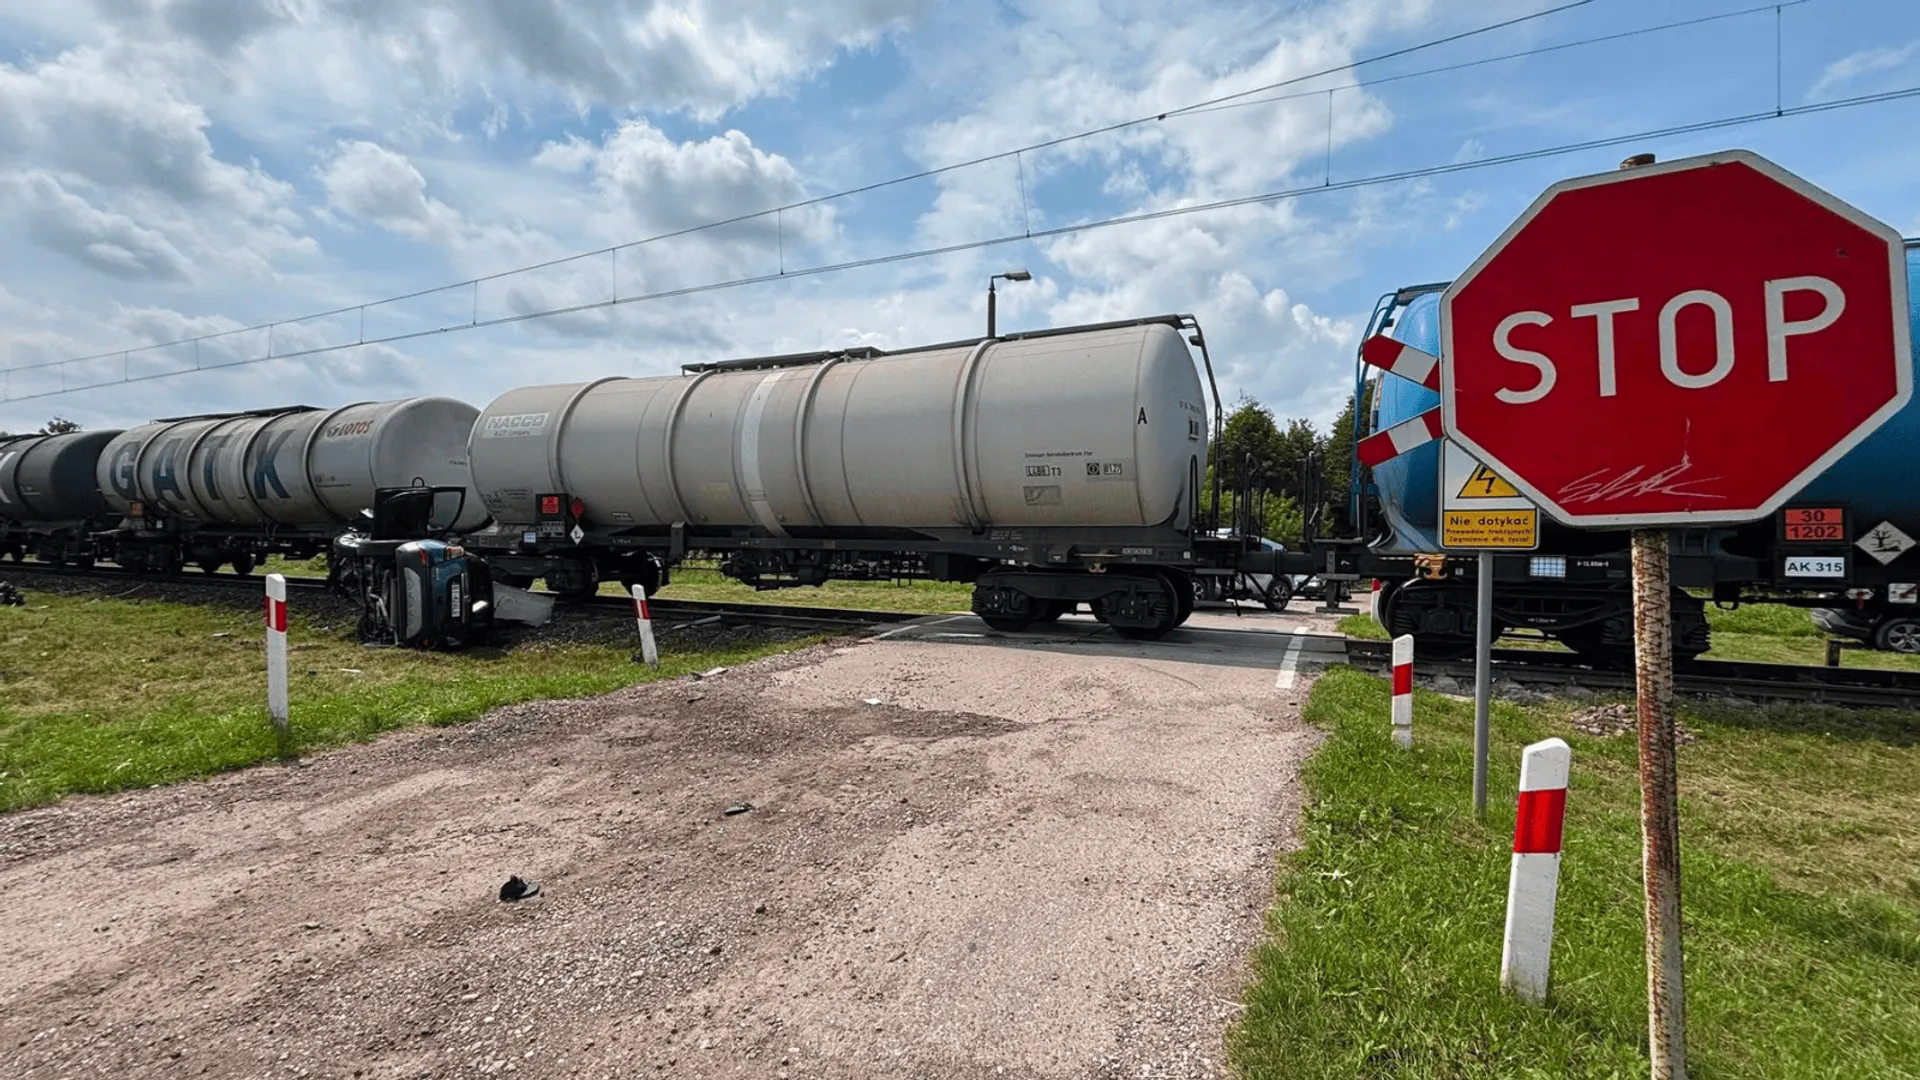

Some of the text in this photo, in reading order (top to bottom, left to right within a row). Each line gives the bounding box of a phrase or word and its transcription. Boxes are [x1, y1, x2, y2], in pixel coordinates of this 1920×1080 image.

[1493, 276, 1846, 404] STOP
[488, 415, 543, 429] NACCO
[1137, 406, 1148, 425] A
[1450, 515, 1529, 527] Nie dotykać
[1801, 510, 1825, 522] 30
[1790, 526, 1838, 539] 1202
[1787, 562, 1842, 572] AK 315
